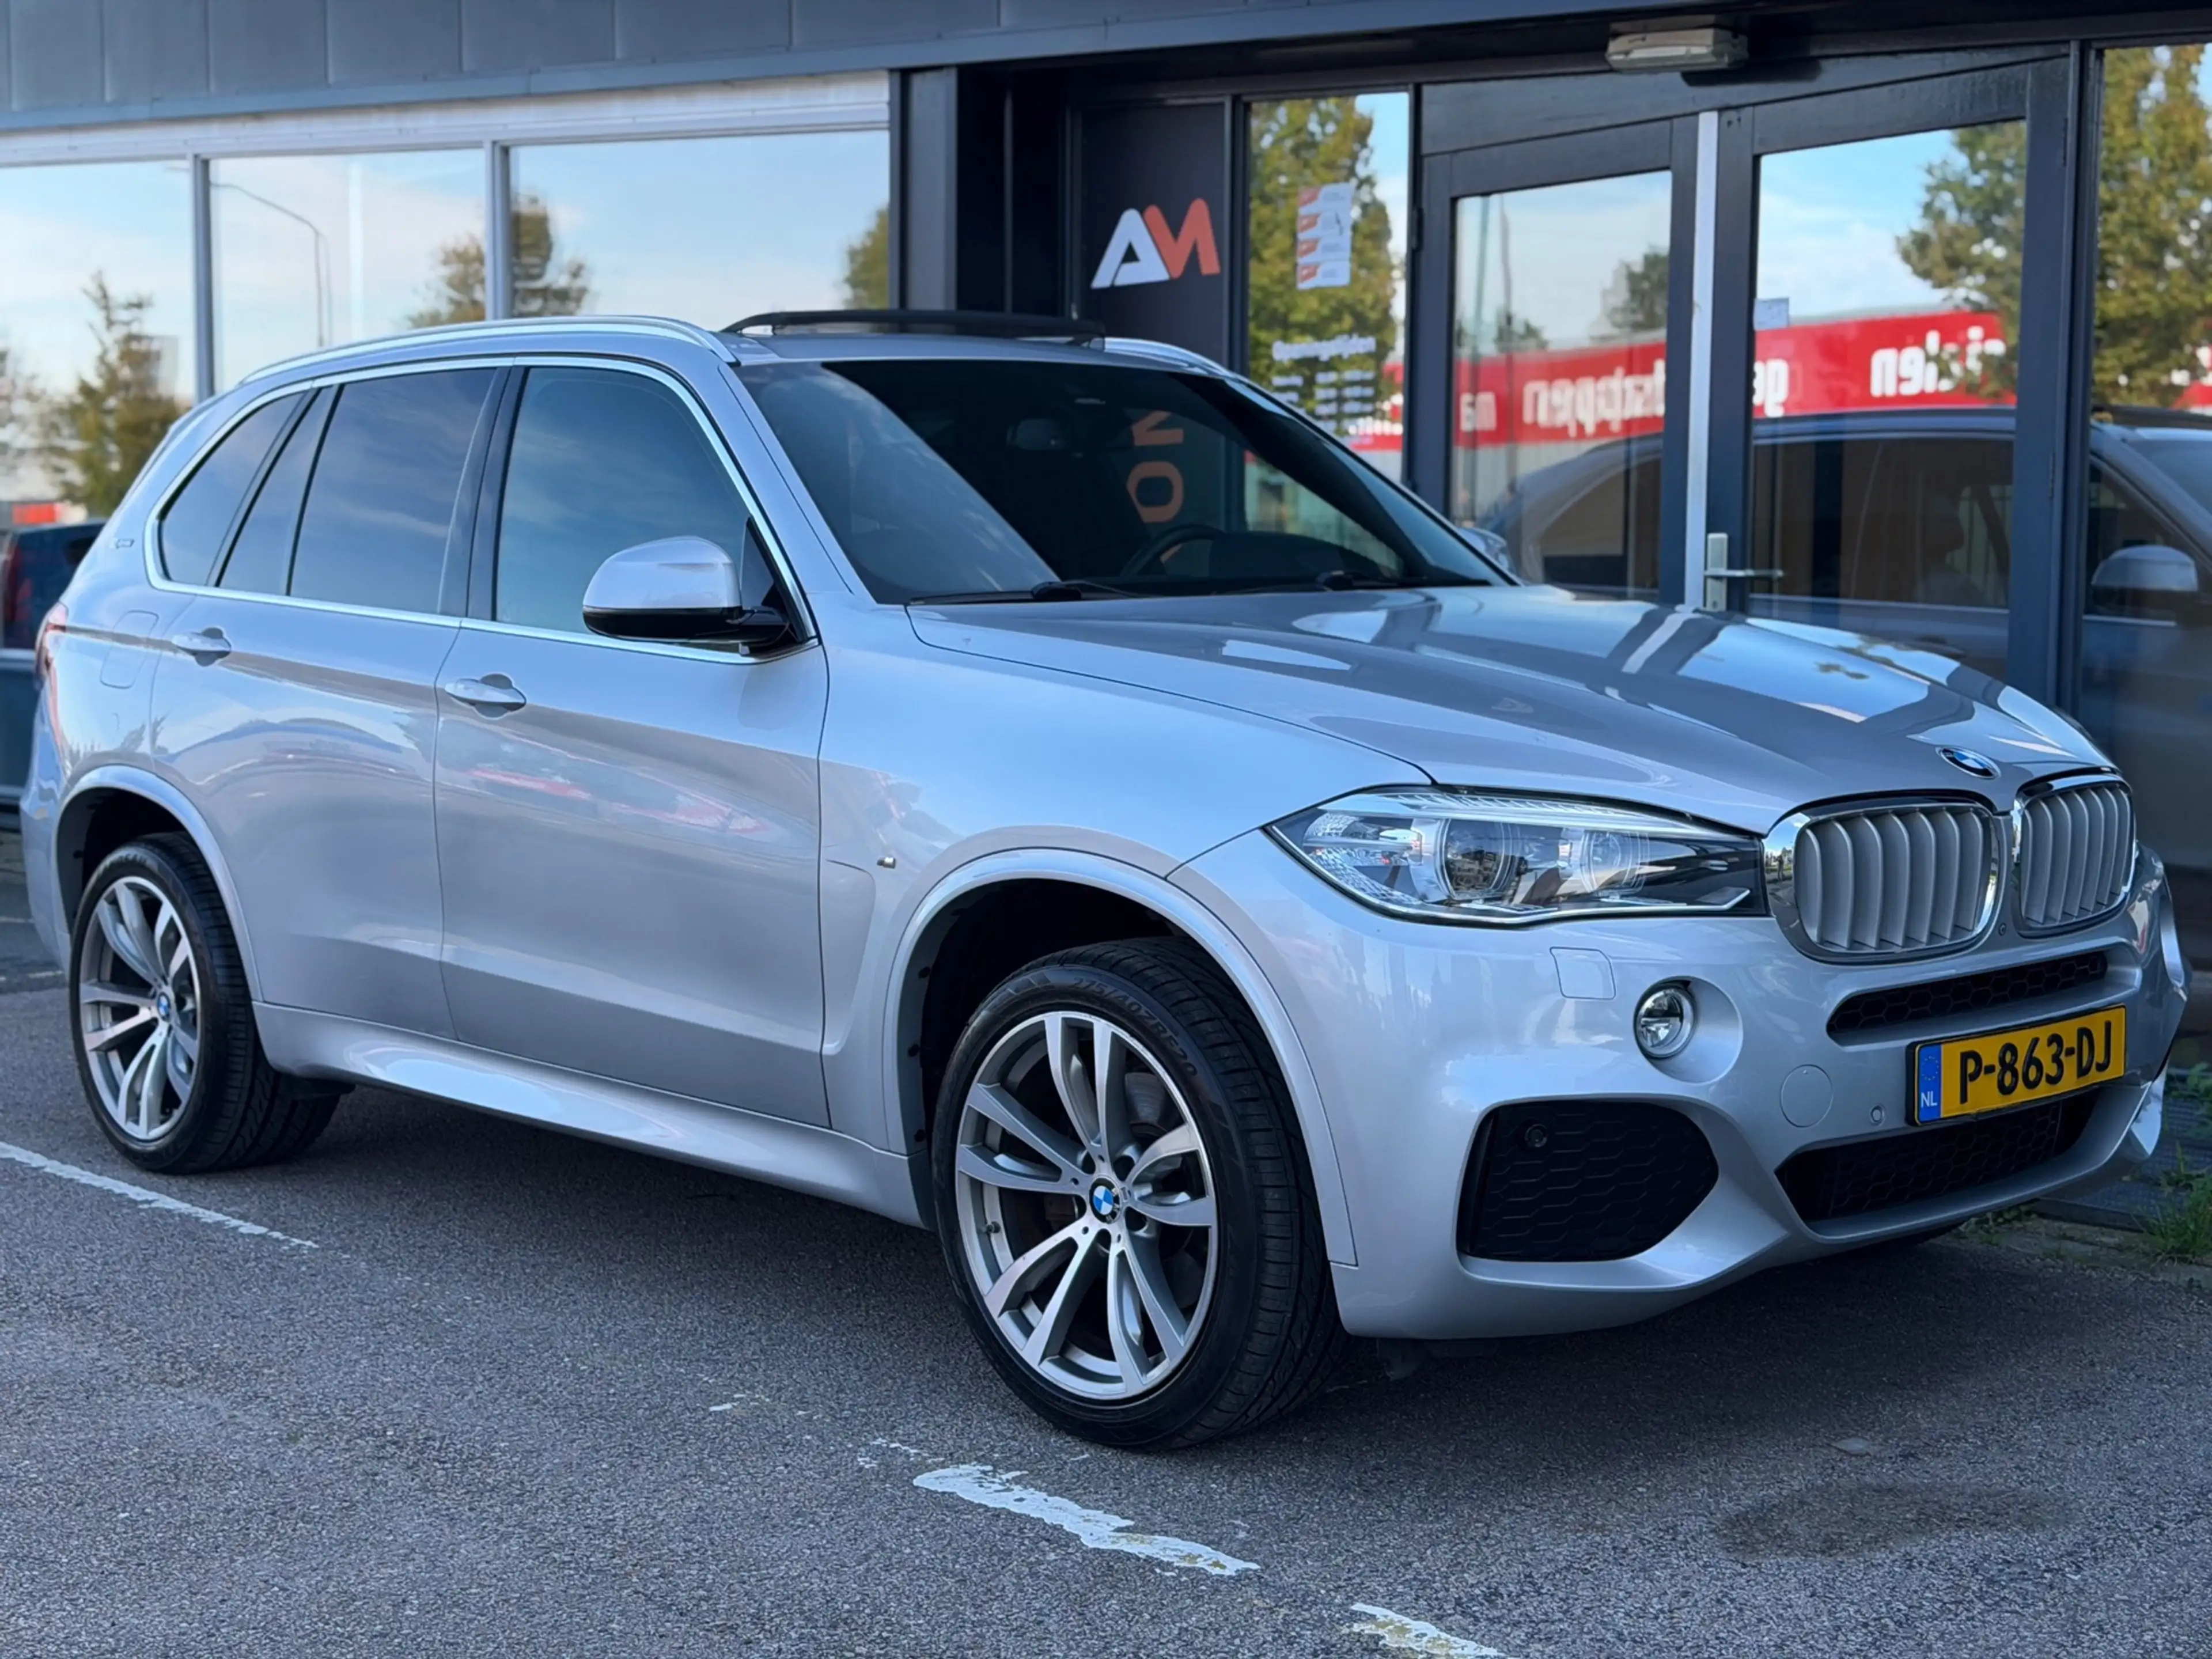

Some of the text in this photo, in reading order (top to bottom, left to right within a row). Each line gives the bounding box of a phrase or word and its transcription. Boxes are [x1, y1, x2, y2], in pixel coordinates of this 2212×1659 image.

[1090, 198, 1221, 289] AM
[1920, 1091, 1937, 1108] NL
[1960, 1020, 2112, 1105] P-863-DJ
